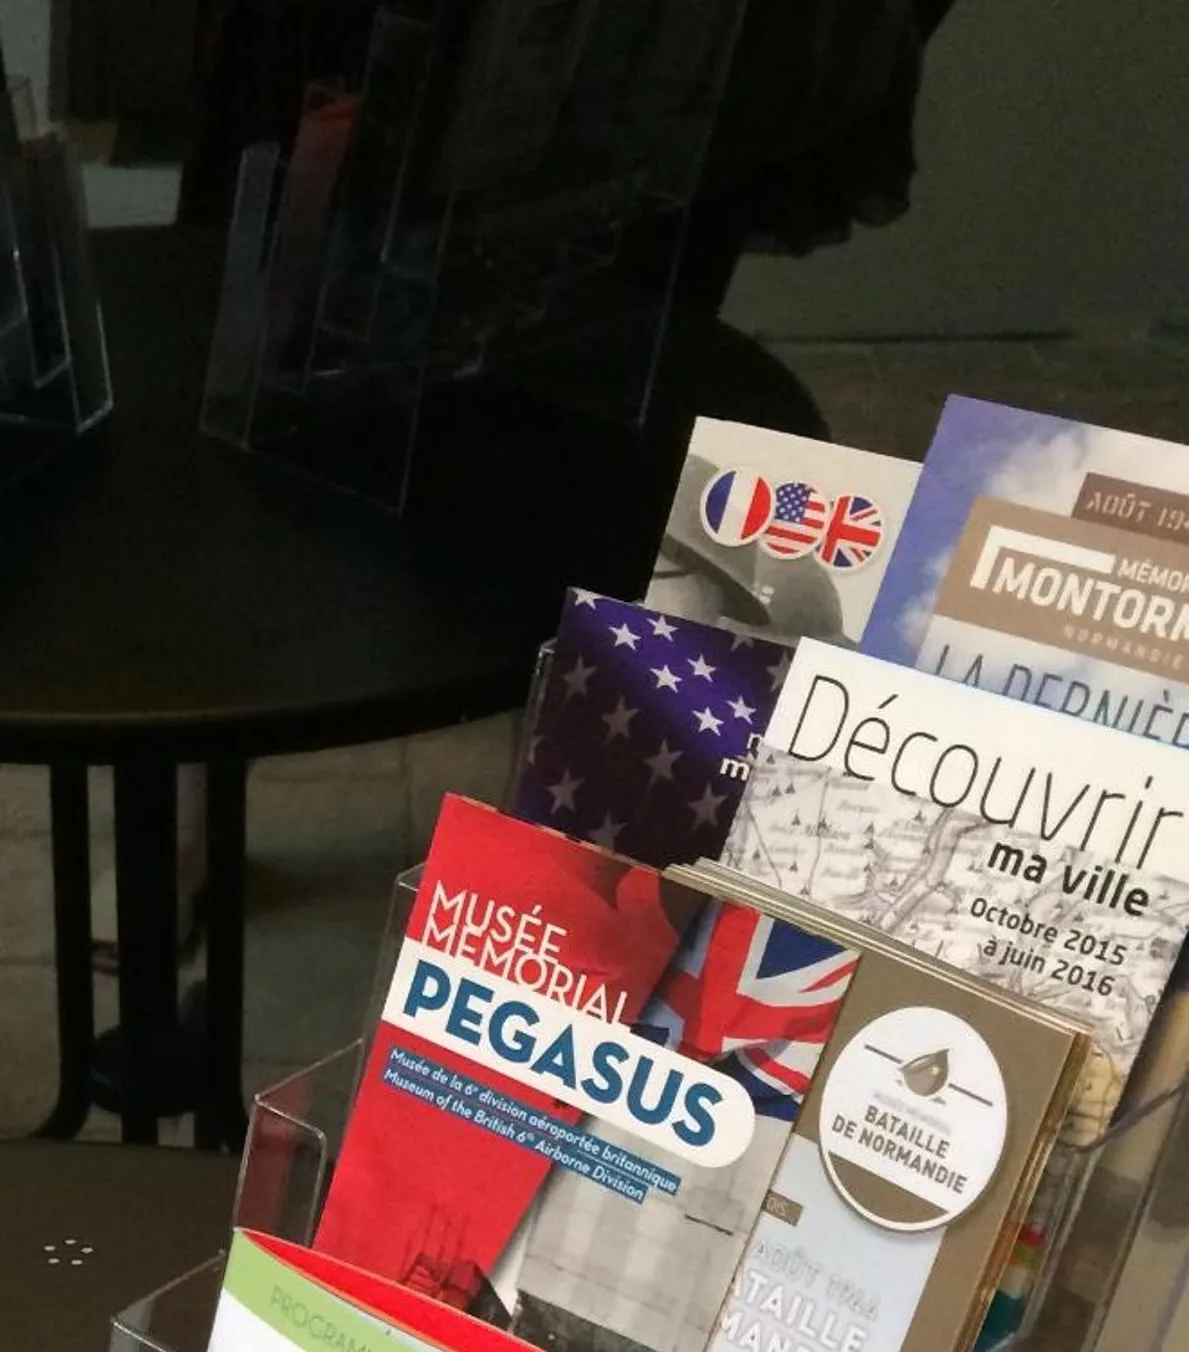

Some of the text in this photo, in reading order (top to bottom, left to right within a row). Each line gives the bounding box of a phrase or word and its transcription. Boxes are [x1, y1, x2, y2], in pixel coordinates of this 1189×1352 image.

[788, 674, 1184, 870] Découvrir
[987, 842, 1150, 917] ma ville
[429, 880, 567, 962] MUSÉE
[970, 897, 1127, 966] Octobre 2015
[984, 935, 1116, 996] à juin 2016
[403, 959, 724, 1147] PEGASUS
[384, 1068, 434, 1101] Museum
[436, 1091, 453, 1112] of
[452, 1100, 473, 1119] the
[474, 1108, 515, 1139] British
[534, 1139, 591, 1174] Airborne
[592, 1163, 645, 1200] Division
[390, 1049, 429, 1077] Musée
[432, 1066, 448, 1086] de
[449, 1076, 463, 1092] la
[479, 1089, 527, 1122] division
[528, 1112, 601, 1155] aéroportée
[602, 1143, 678, 1194] britannique
[832, 1113, 968, 1195] DE NORMANDIE
[864, 1104, 951, 1159] BATAILLE
